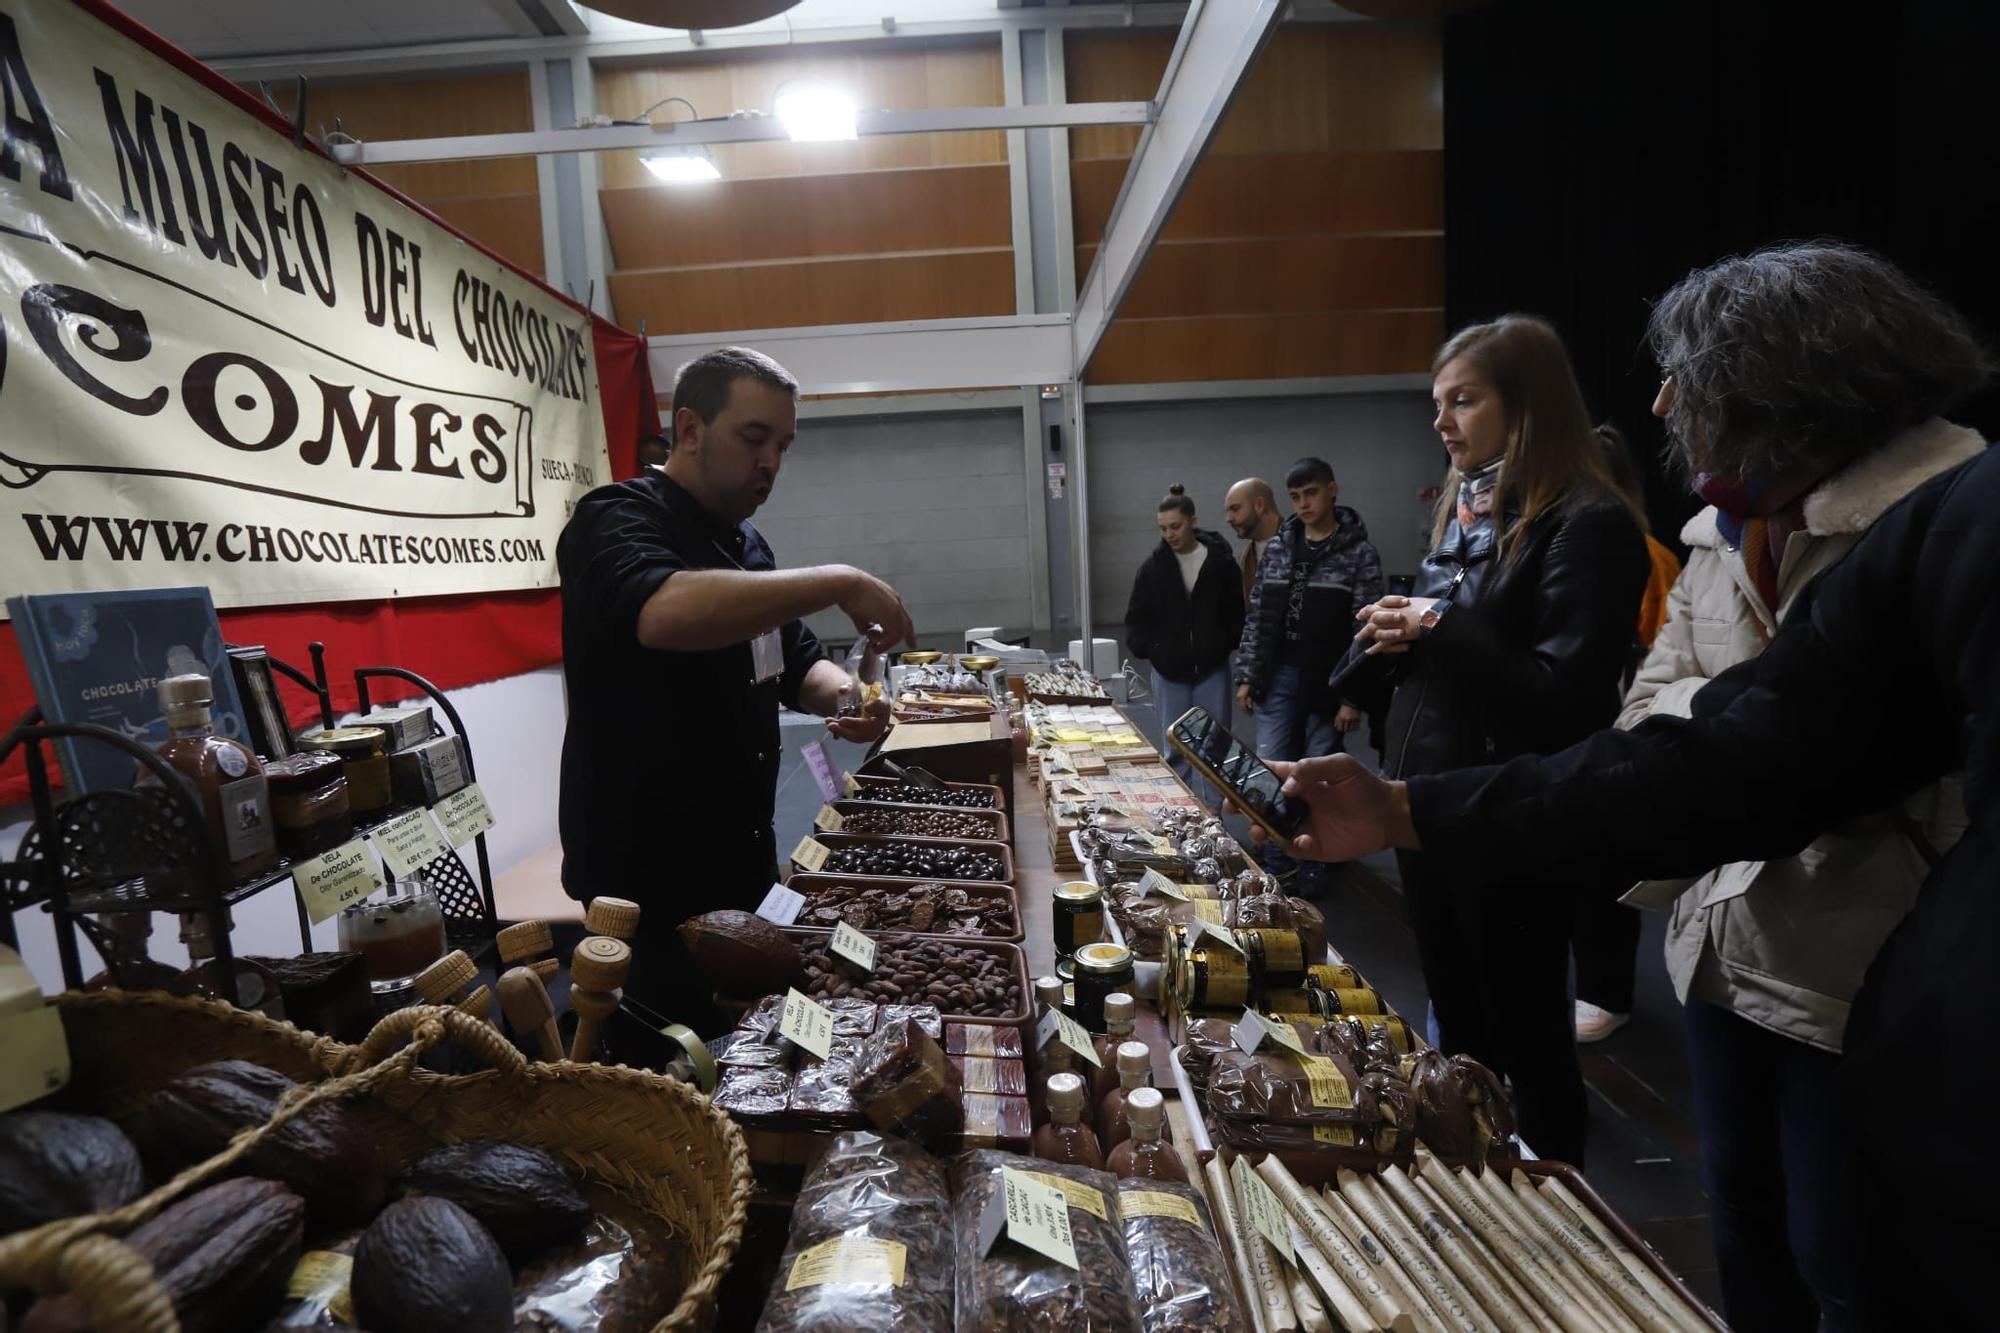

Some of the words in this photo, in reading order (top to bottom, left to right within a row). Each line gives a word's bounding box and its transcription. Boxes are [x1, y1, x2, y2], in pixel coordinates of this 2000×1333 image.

[93, 66, 336, 308] MUSEO
[354, 211, 438, 351] DEL
[453, 268, 587, 404] CHOCOLATE
[542, 458, 570, 480] SUECA
[22, 513, 545, 563] WWW.CHOCOLATESCOMES.COM
[81, 677, 158, 700] CHOCOLATE
[451, 794, 479, 814] CHOCOLATE
[376, 825, 391, 837] MIEL
[391, 821, 402, 830] con
[400, 810, 421, 825] CACAO
[309, 873, 321, 884] De
[320, 852, 363, 879] CHOCOLATE
[321, 850, 341, 865] VELA
[405, 854, 418, 865] 4.50
[338, 889, 353, 902] 4.50
[1006, 1178, 1018, 1223] CASCARILLA
[1019, 1186, 1030, 1216] CACAO
[1023, 1214, 1031, 1226] de
[1047, 1223, 1057, 1239] Una
[1060, 1230, 1070, 1246] Dos
